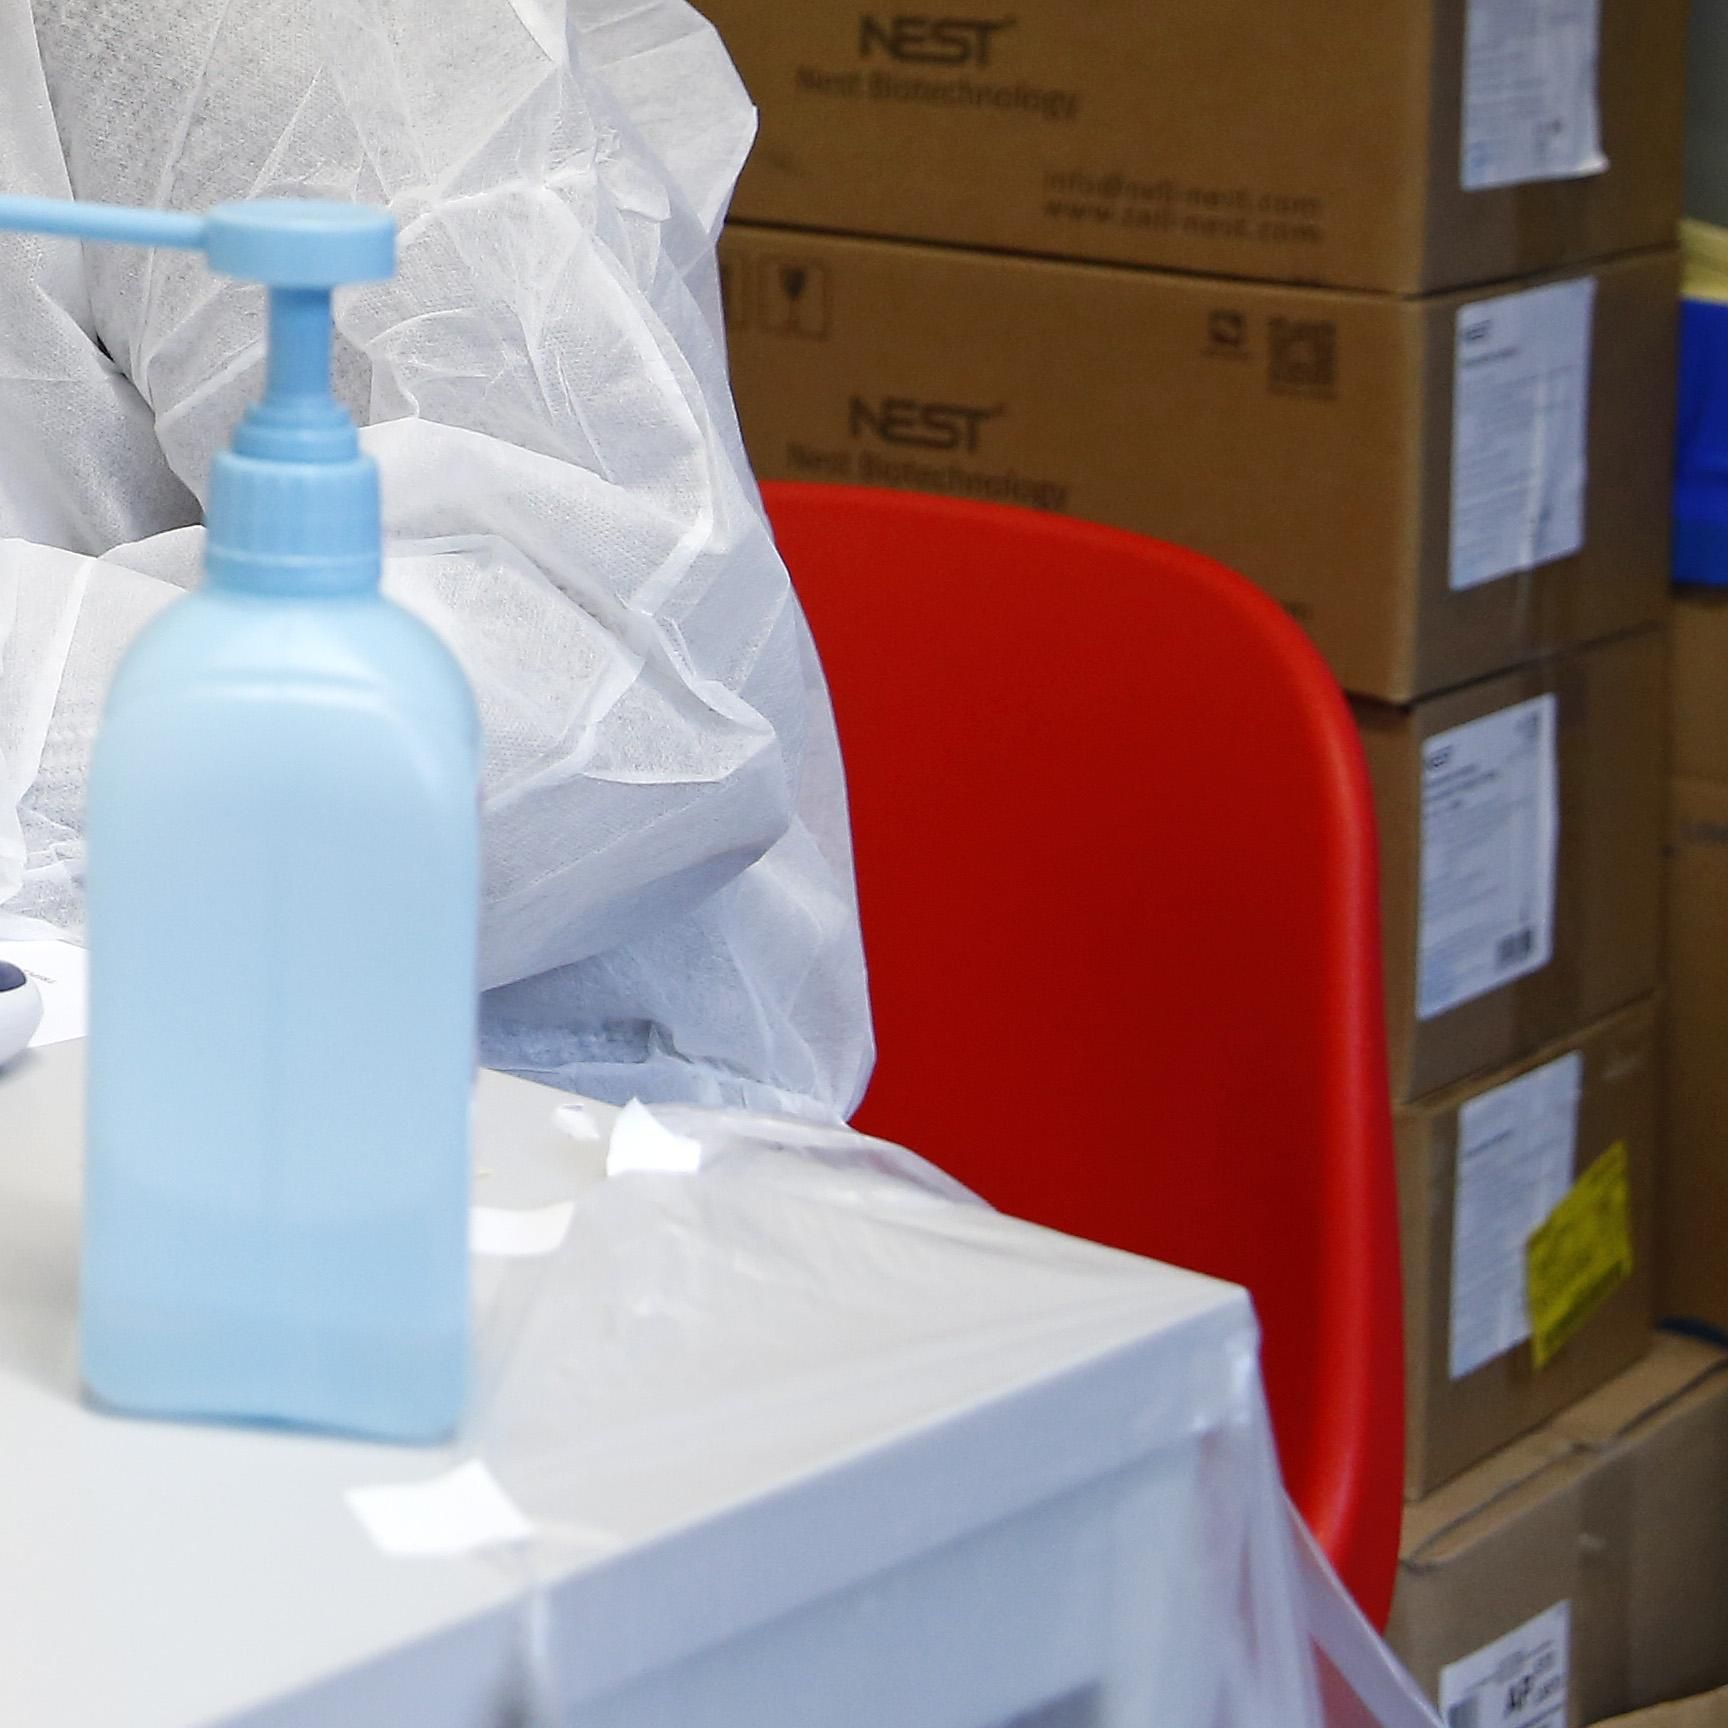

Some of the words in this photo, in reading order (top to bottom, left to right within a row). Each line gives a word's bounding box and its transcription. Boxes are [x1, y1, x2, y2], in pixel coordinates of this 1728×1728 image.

[859, 13, 1016, 69] NEST
[796, 65, 861, 99] Nest
[869, 71, 1079, 123] Biotechnology
[848, 395, 1007, 454] NEST
